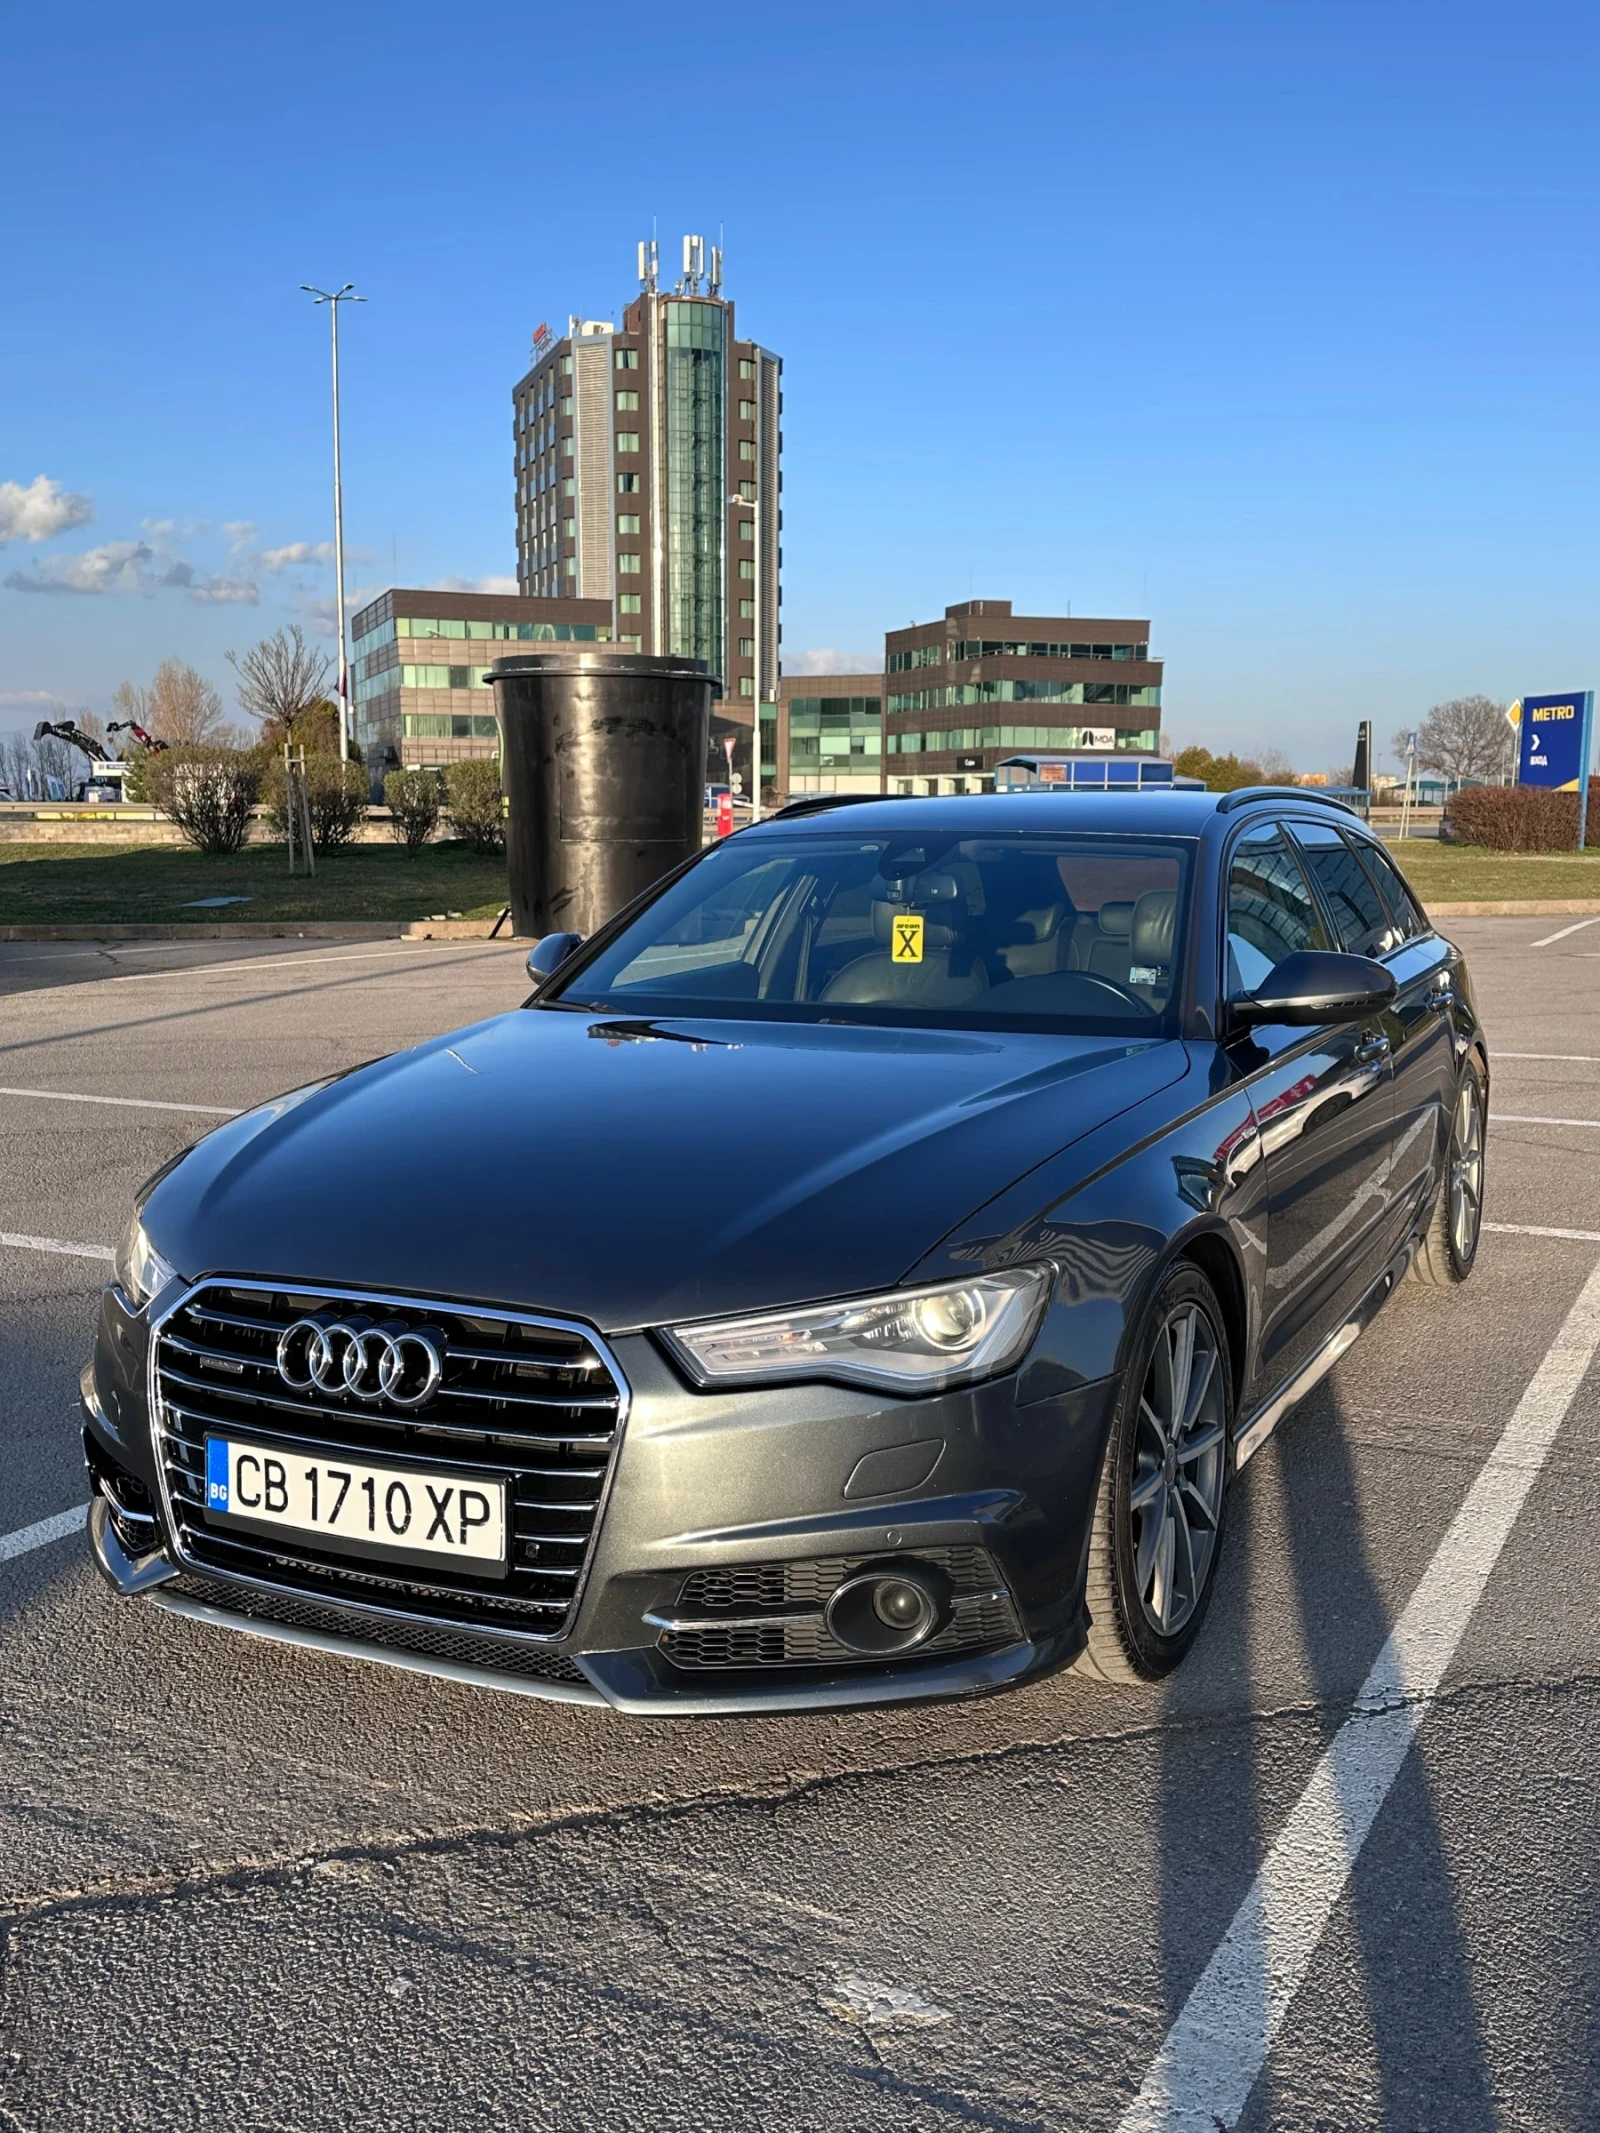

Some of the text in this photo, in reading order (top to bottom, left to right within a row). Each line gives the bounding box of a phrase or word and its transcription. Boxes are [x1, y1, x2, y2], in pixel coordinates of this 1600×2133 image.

[1532, 705, 1575, 722] METRO
[1095, 735, 1114, 744] MDA
[896, 930, 919, 957] X
[210, 1483, 227, 1500] BG
[236, 1454, 491, 1545] CB 1710 XP
